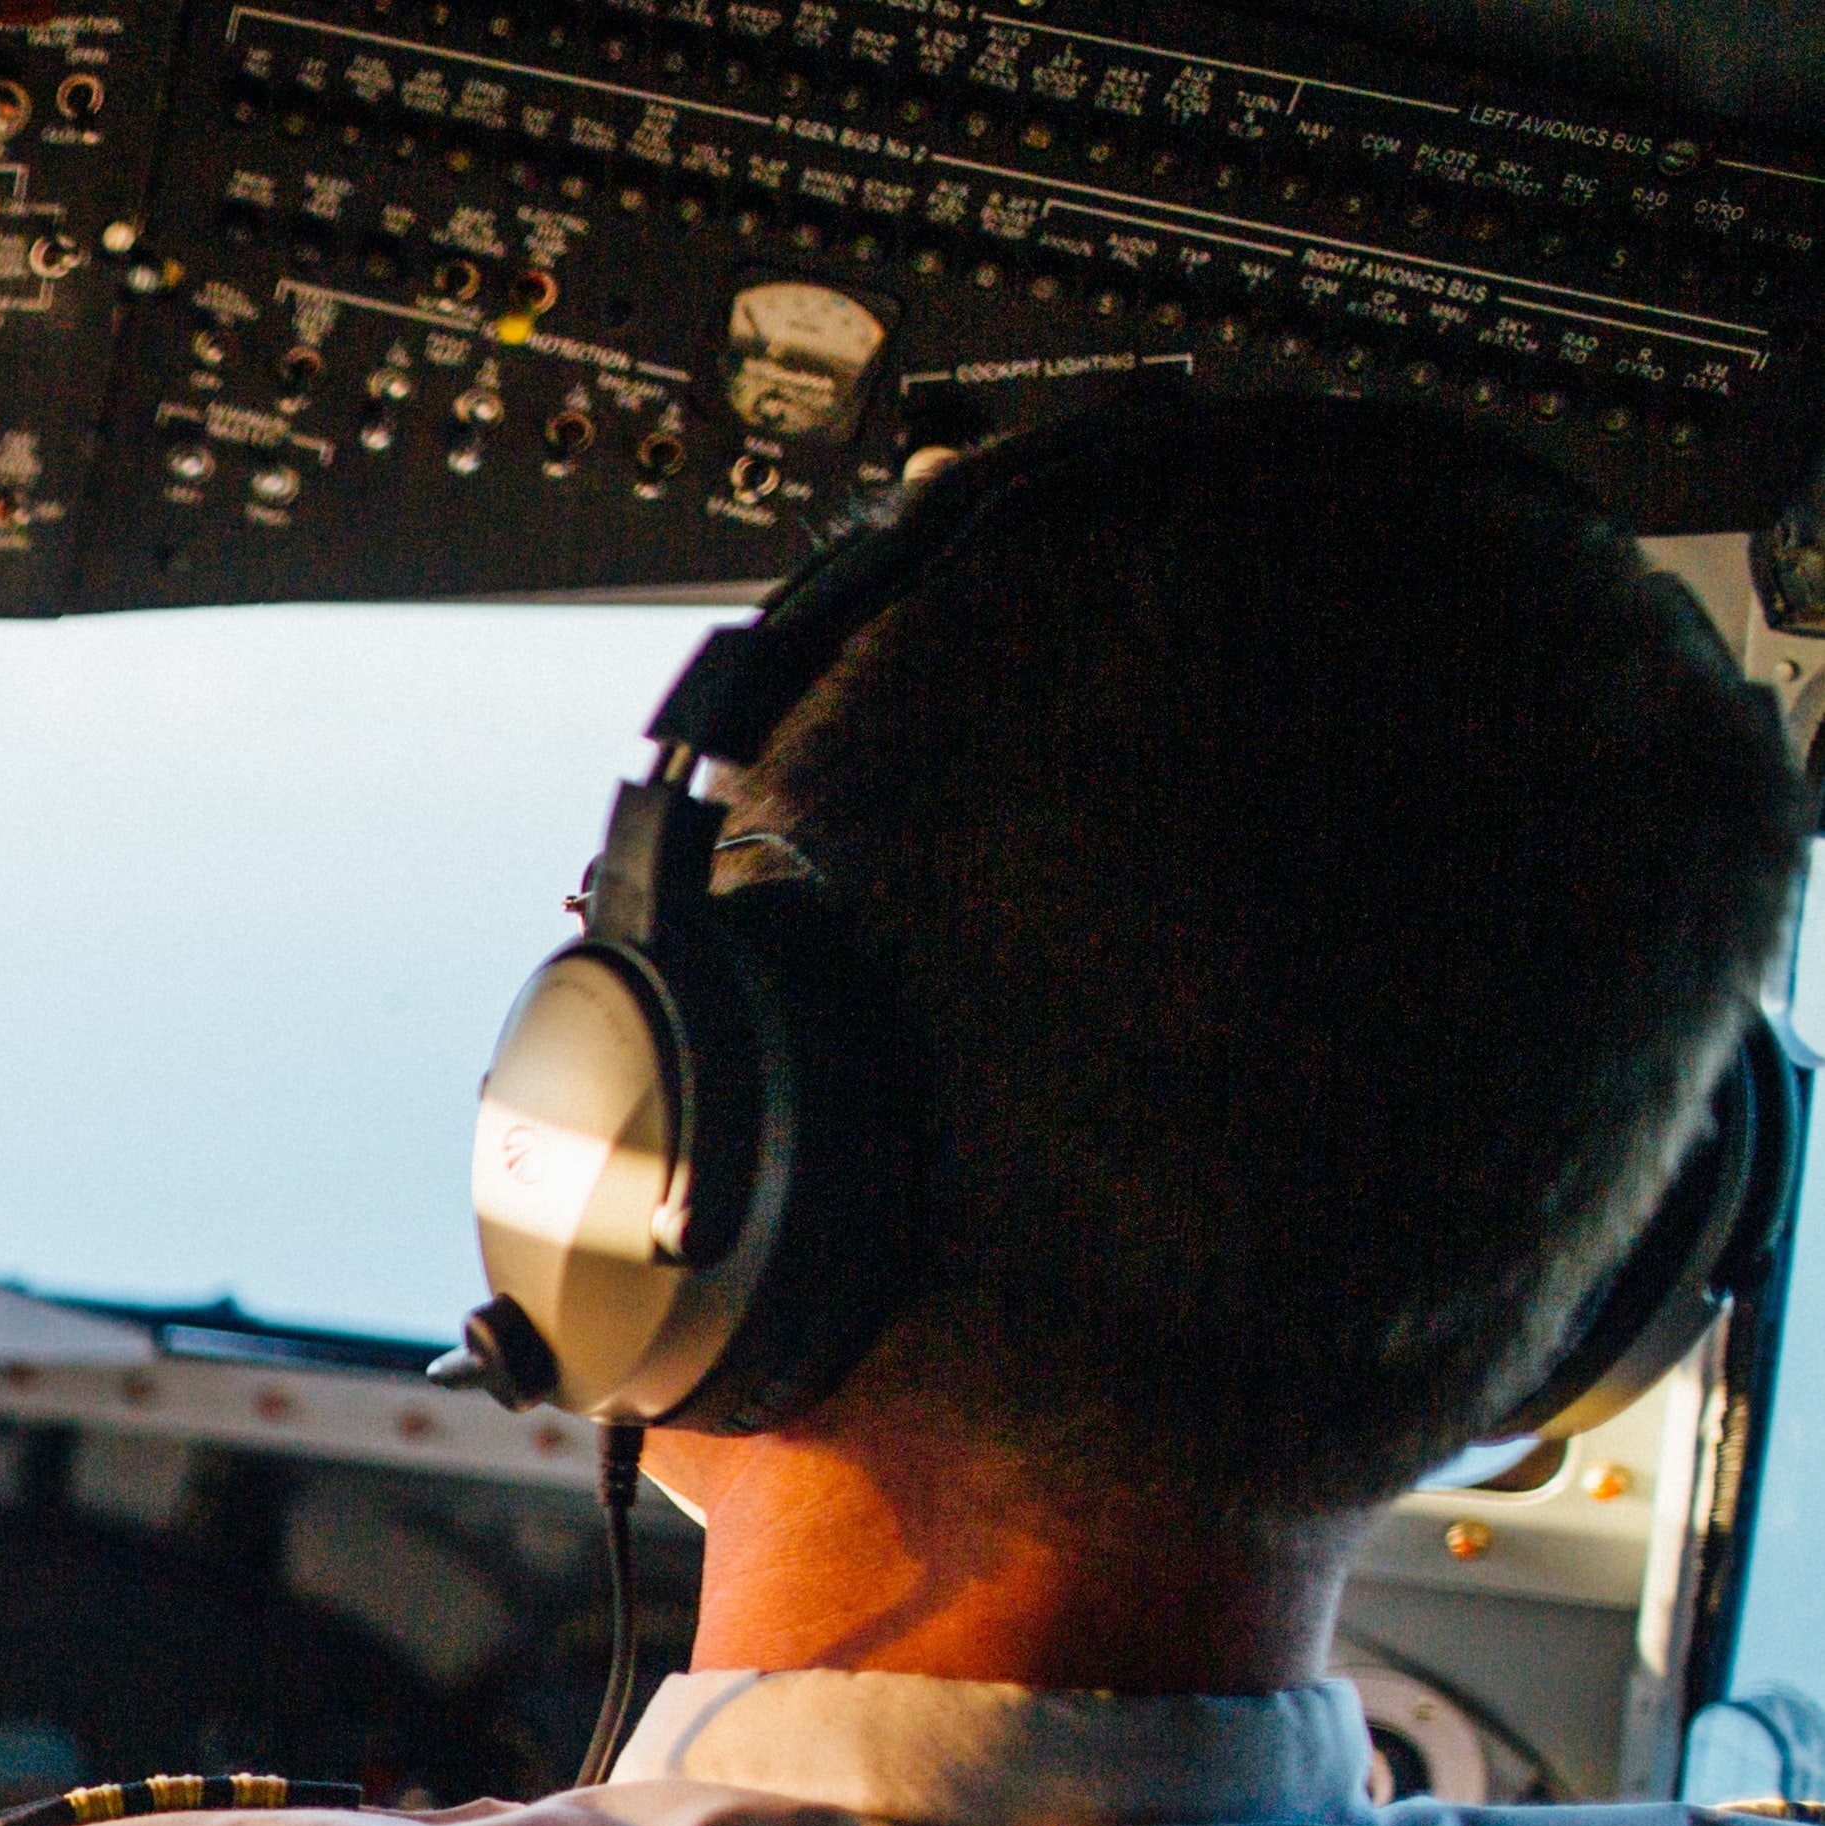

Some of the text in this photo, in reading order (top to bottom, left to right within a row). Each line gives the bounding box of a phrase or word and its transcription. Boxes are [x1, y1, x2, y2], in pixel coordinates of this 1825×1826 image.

[1237, 89, 1280, 113] TURN
[794, 117, 838, 143] GEN
[838, 127, 882, 153] BUS
[1295, 120, 1335, 141] NAV
[1468, 103, 1654, 156] LEFT AVIONICS BUS
[1361, 133, 1402, 154] COM
[1416, 142, 1479, 170] PILOTS
[1497, 159, 1532, 180] SKY
[1561, 173, 1600, 196] ENC
[1631, 186, 1669, 208] RAD
[1694, 198, 1745, 222] GYRO
[1239, 261, 1276, 281] NAV
[1301, 247, 1489, 303] RIGHT AVIONICS BUS
[1300, 274, 1340, 296] COM
[1495, 317, 1532, 336] SKY
[1478, 328, 1540, 354] WATCH
[1561, 331, 1600, 352] RAD
[955, 352, 1136, 384] COCKPIT LIGHTING
[1615, 357, 1666, 382] GYRO
[1699, 361, 1730, 380] XM
[1683, 372, 1730, 396] DATA
